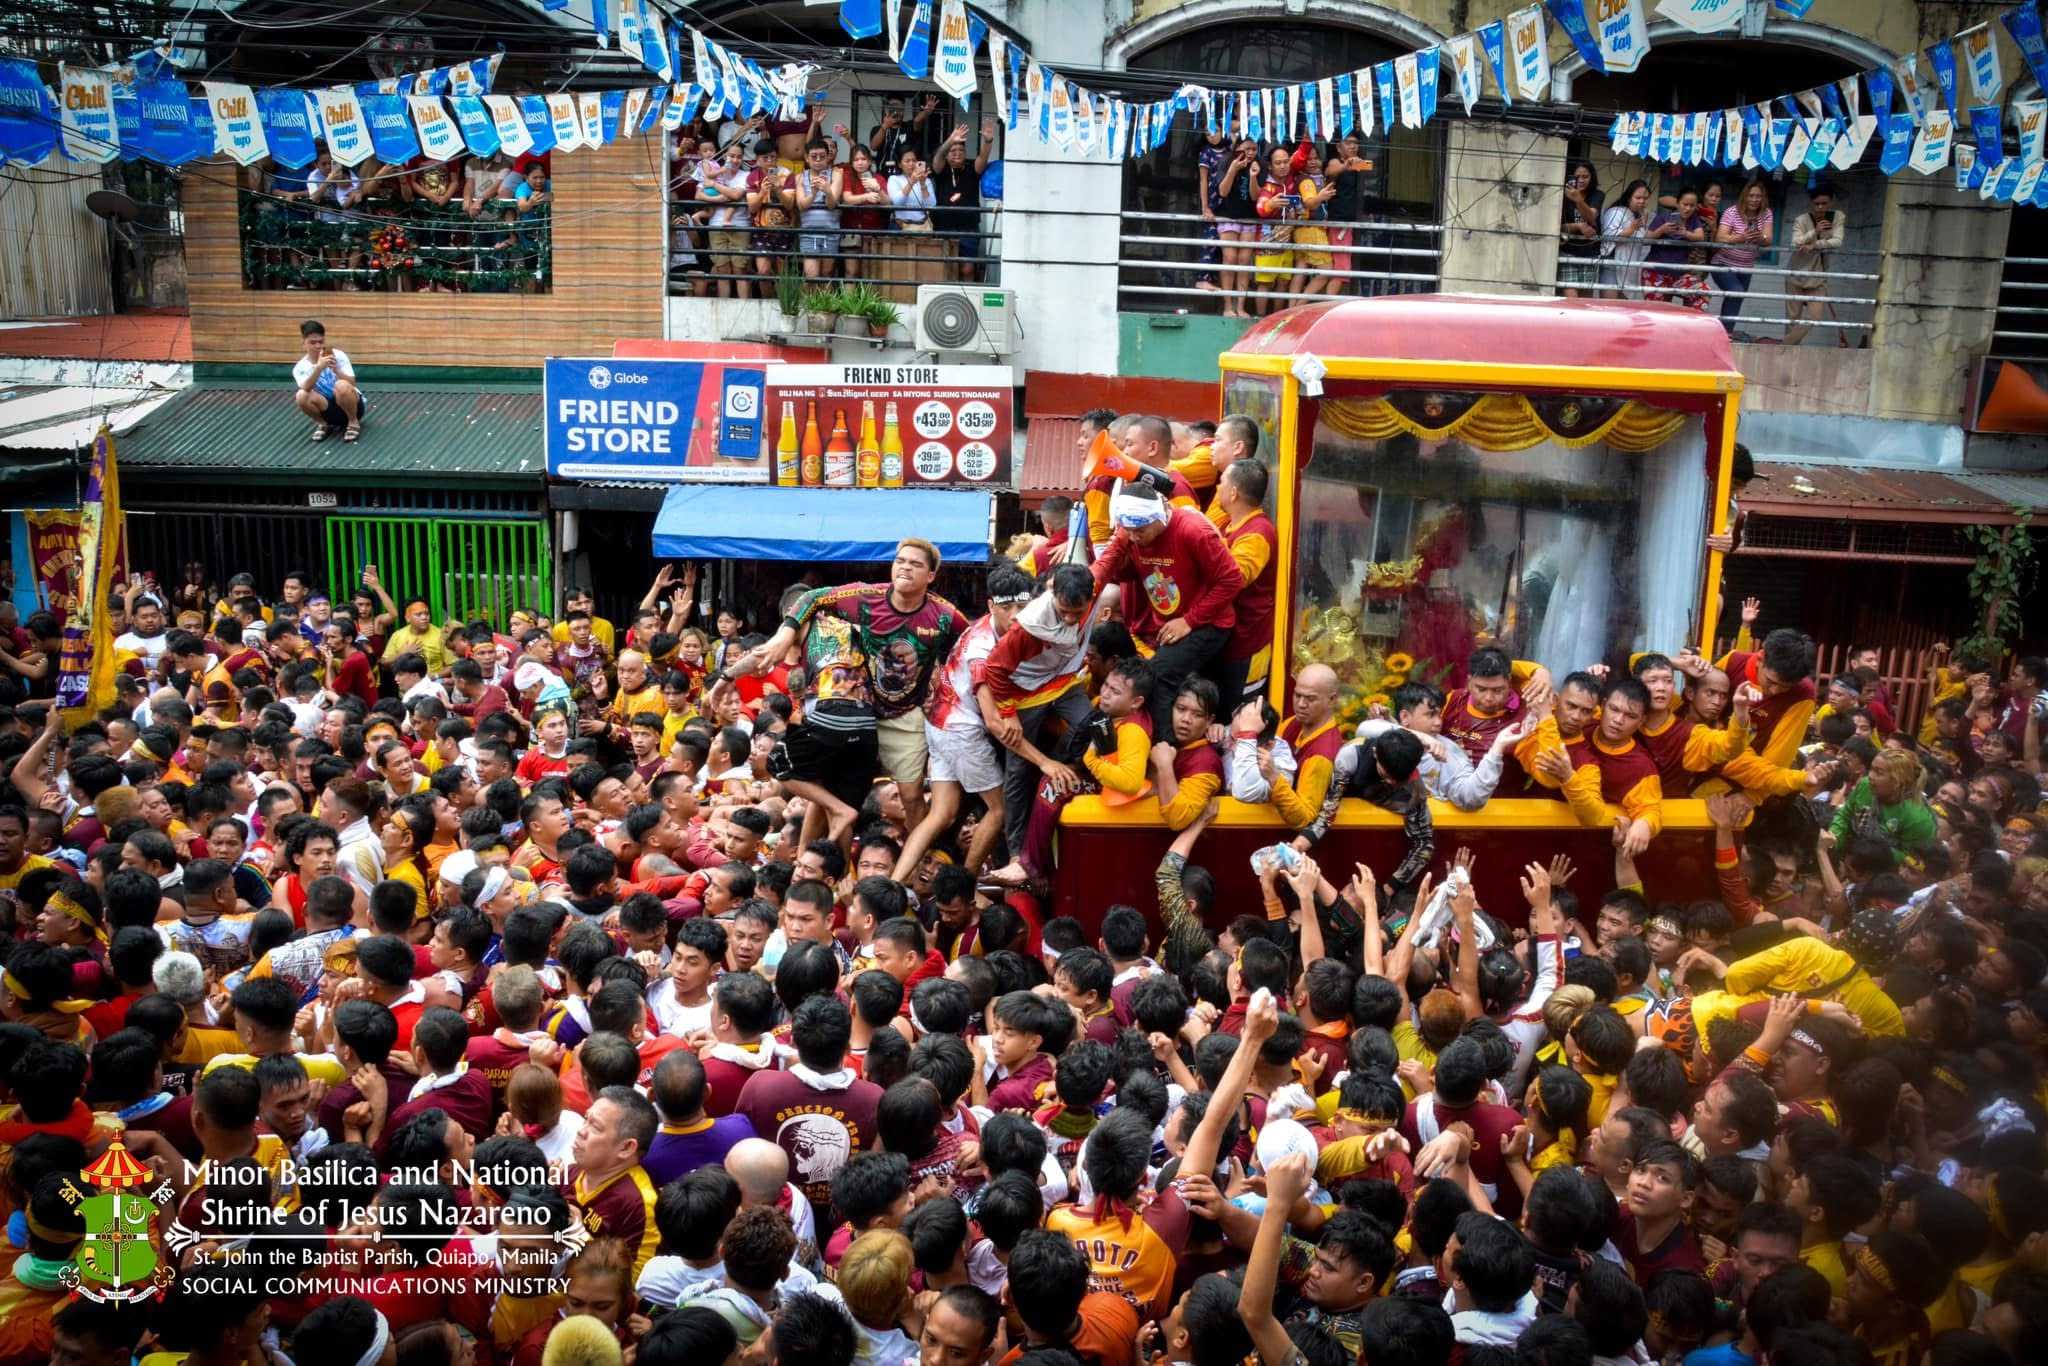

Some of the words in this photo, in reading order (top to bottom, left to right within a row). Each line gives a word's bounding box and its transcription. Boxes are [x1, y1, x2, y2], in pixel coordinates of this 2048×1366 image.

[66, 84, 106, 110] Chill
[217, 97, 248, 119] Chill
[326, 103, 354, 126] Chill
[614, 372, 648, 385] Globe
[845, 367, 891, 384] FRIEND
[897, 368, 939, 384] STORE
[560, 399, 679, 425] FRIEND
[567, 427, 671, 454] STORE
